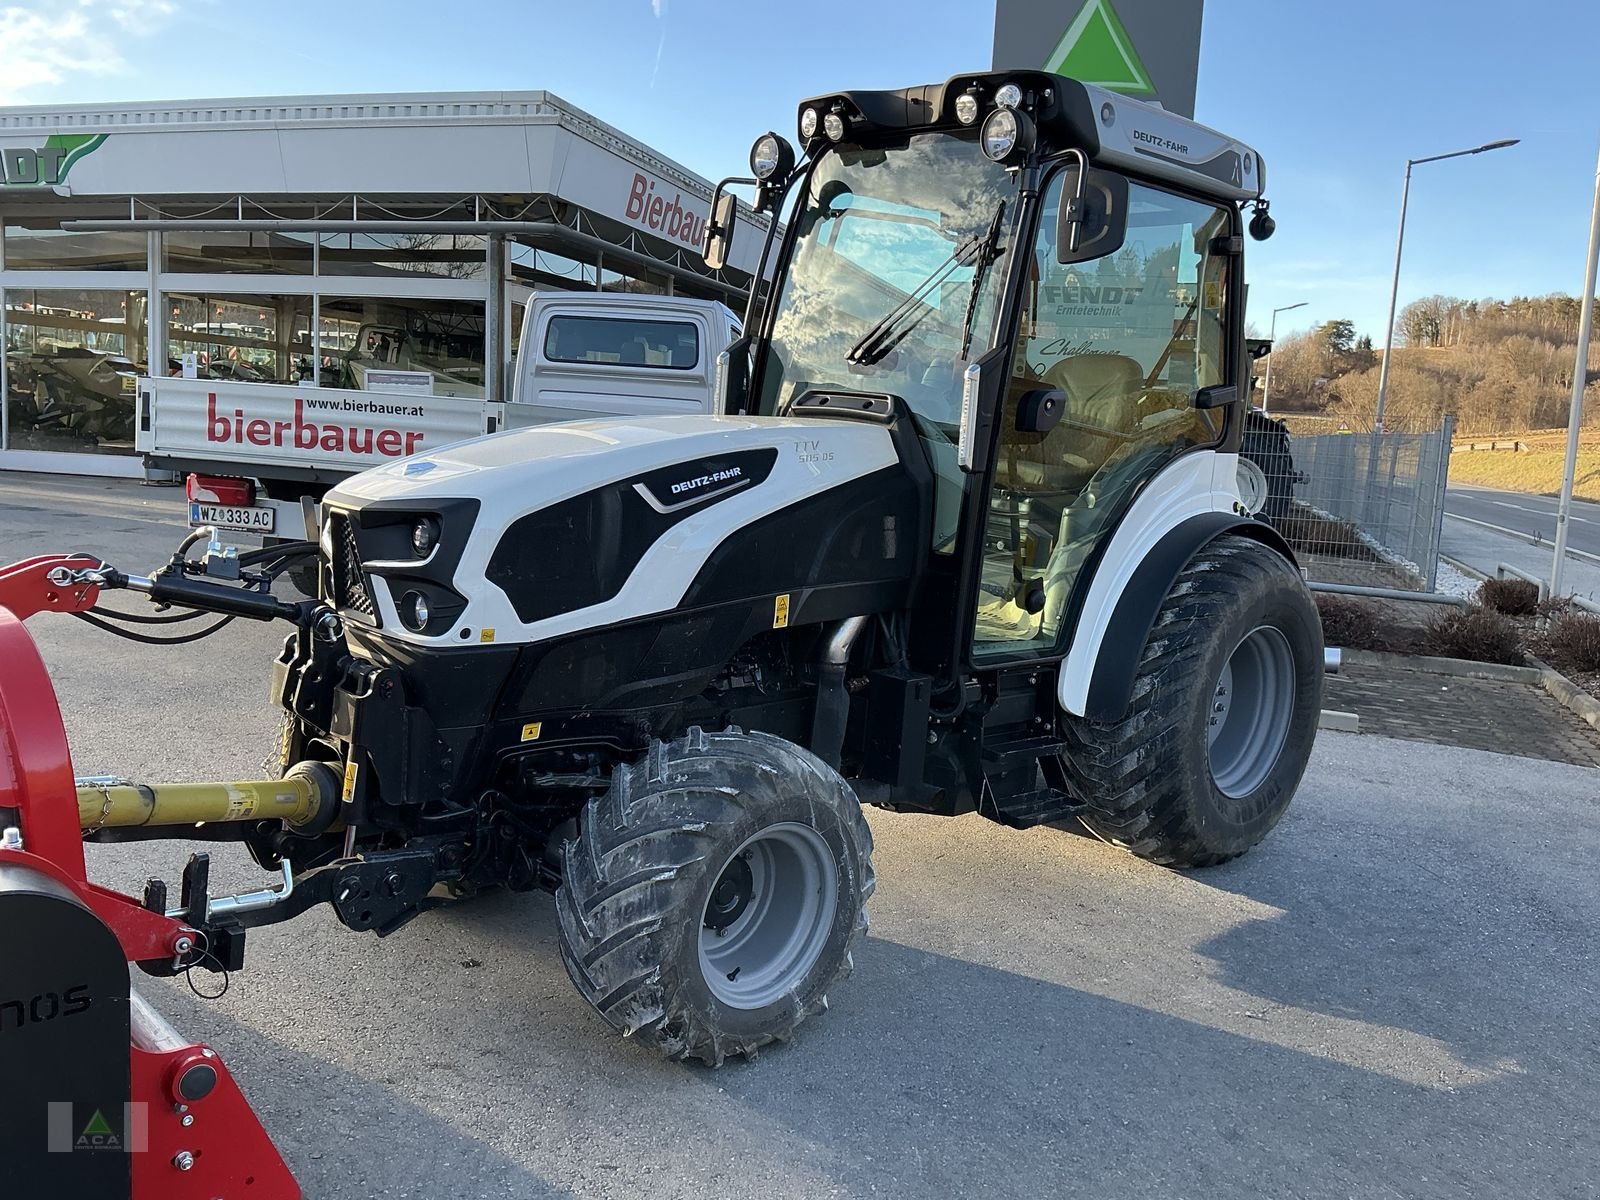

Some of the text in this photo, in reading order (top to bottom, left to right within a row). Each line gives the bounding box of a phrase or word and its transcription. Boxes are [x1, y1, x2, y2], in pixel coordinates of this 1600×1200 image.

[1133, 129, 1189, 155] DEUTZ-FAHR
[0, 148, 67, 184] DT
[625, 172, 706, 248] Bierbau
[1044, 286, 1144, 305] FENDT
[1055, 305, 1122, 317] Erntetechnik
[306, 399, 425, 417] www.bierbauer.at
[206, 392, 425, 456] bierbauer
[793, 440, 820, 452] TTV
[671, 466, 742, 494] DEUTZ-FAHR
[200, 506, 270, 526] WZ 333 AC
